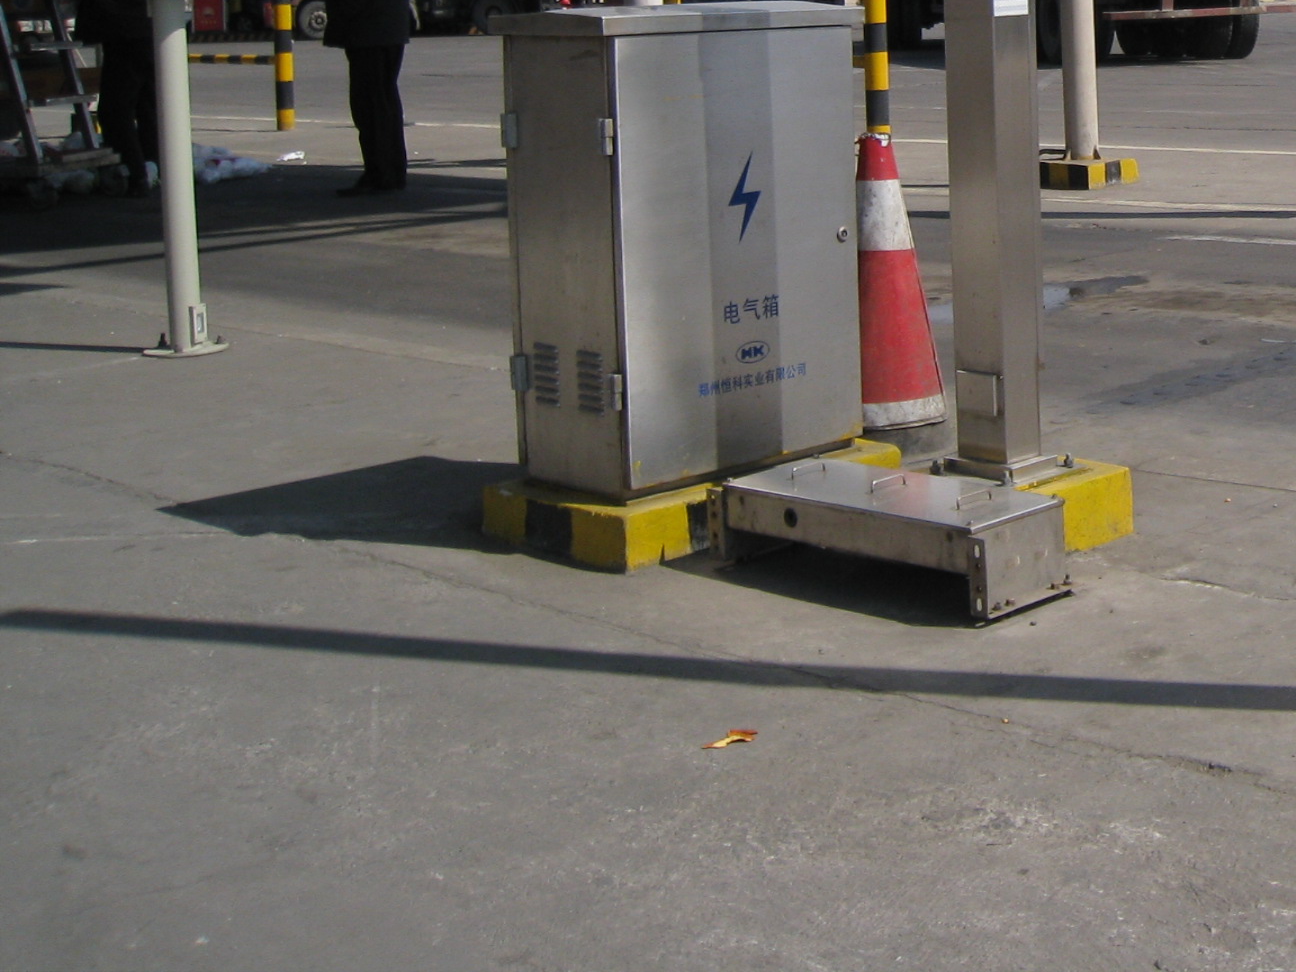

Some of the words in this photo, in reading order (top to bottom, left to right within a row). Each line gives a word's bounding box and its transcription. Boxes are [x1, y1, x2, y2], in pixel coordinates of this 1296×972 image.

[723, 293, 780, 326] 电气箱
[697, 362, 808, 397] 郑州恒科实业有限公司
